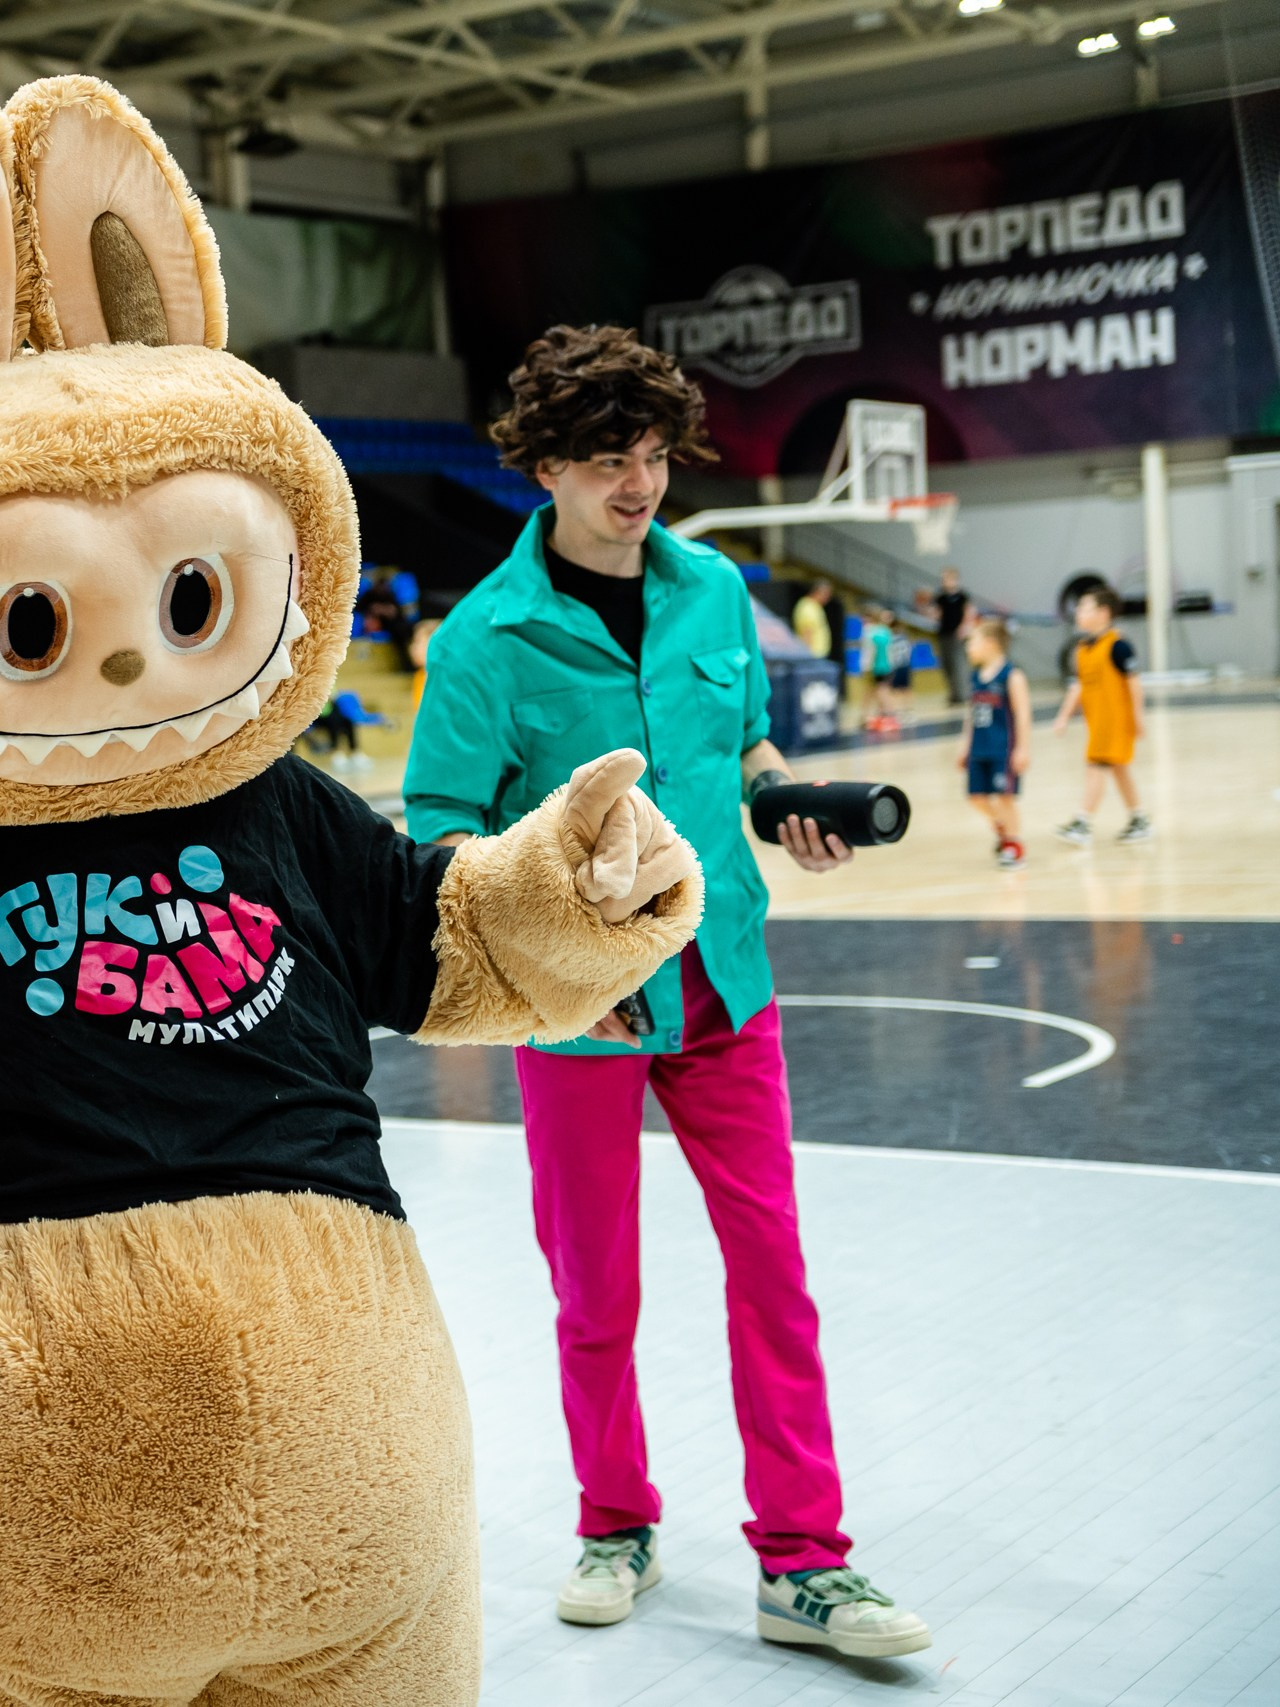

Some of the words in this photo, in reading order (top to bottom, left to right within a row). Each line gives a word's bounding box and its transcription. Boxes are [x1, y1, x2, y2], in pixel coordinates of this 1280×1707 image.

[925, 179, 1186, 270] ТОРПЕДО
[658, 296, 847, 358] ТОРПЕДО
[939, 305, 1177, 391] НОРМАН
[74, 891, 283, 1019] БАМА
[127, 946, 297, 1045] МУЛЬТИПАРК
